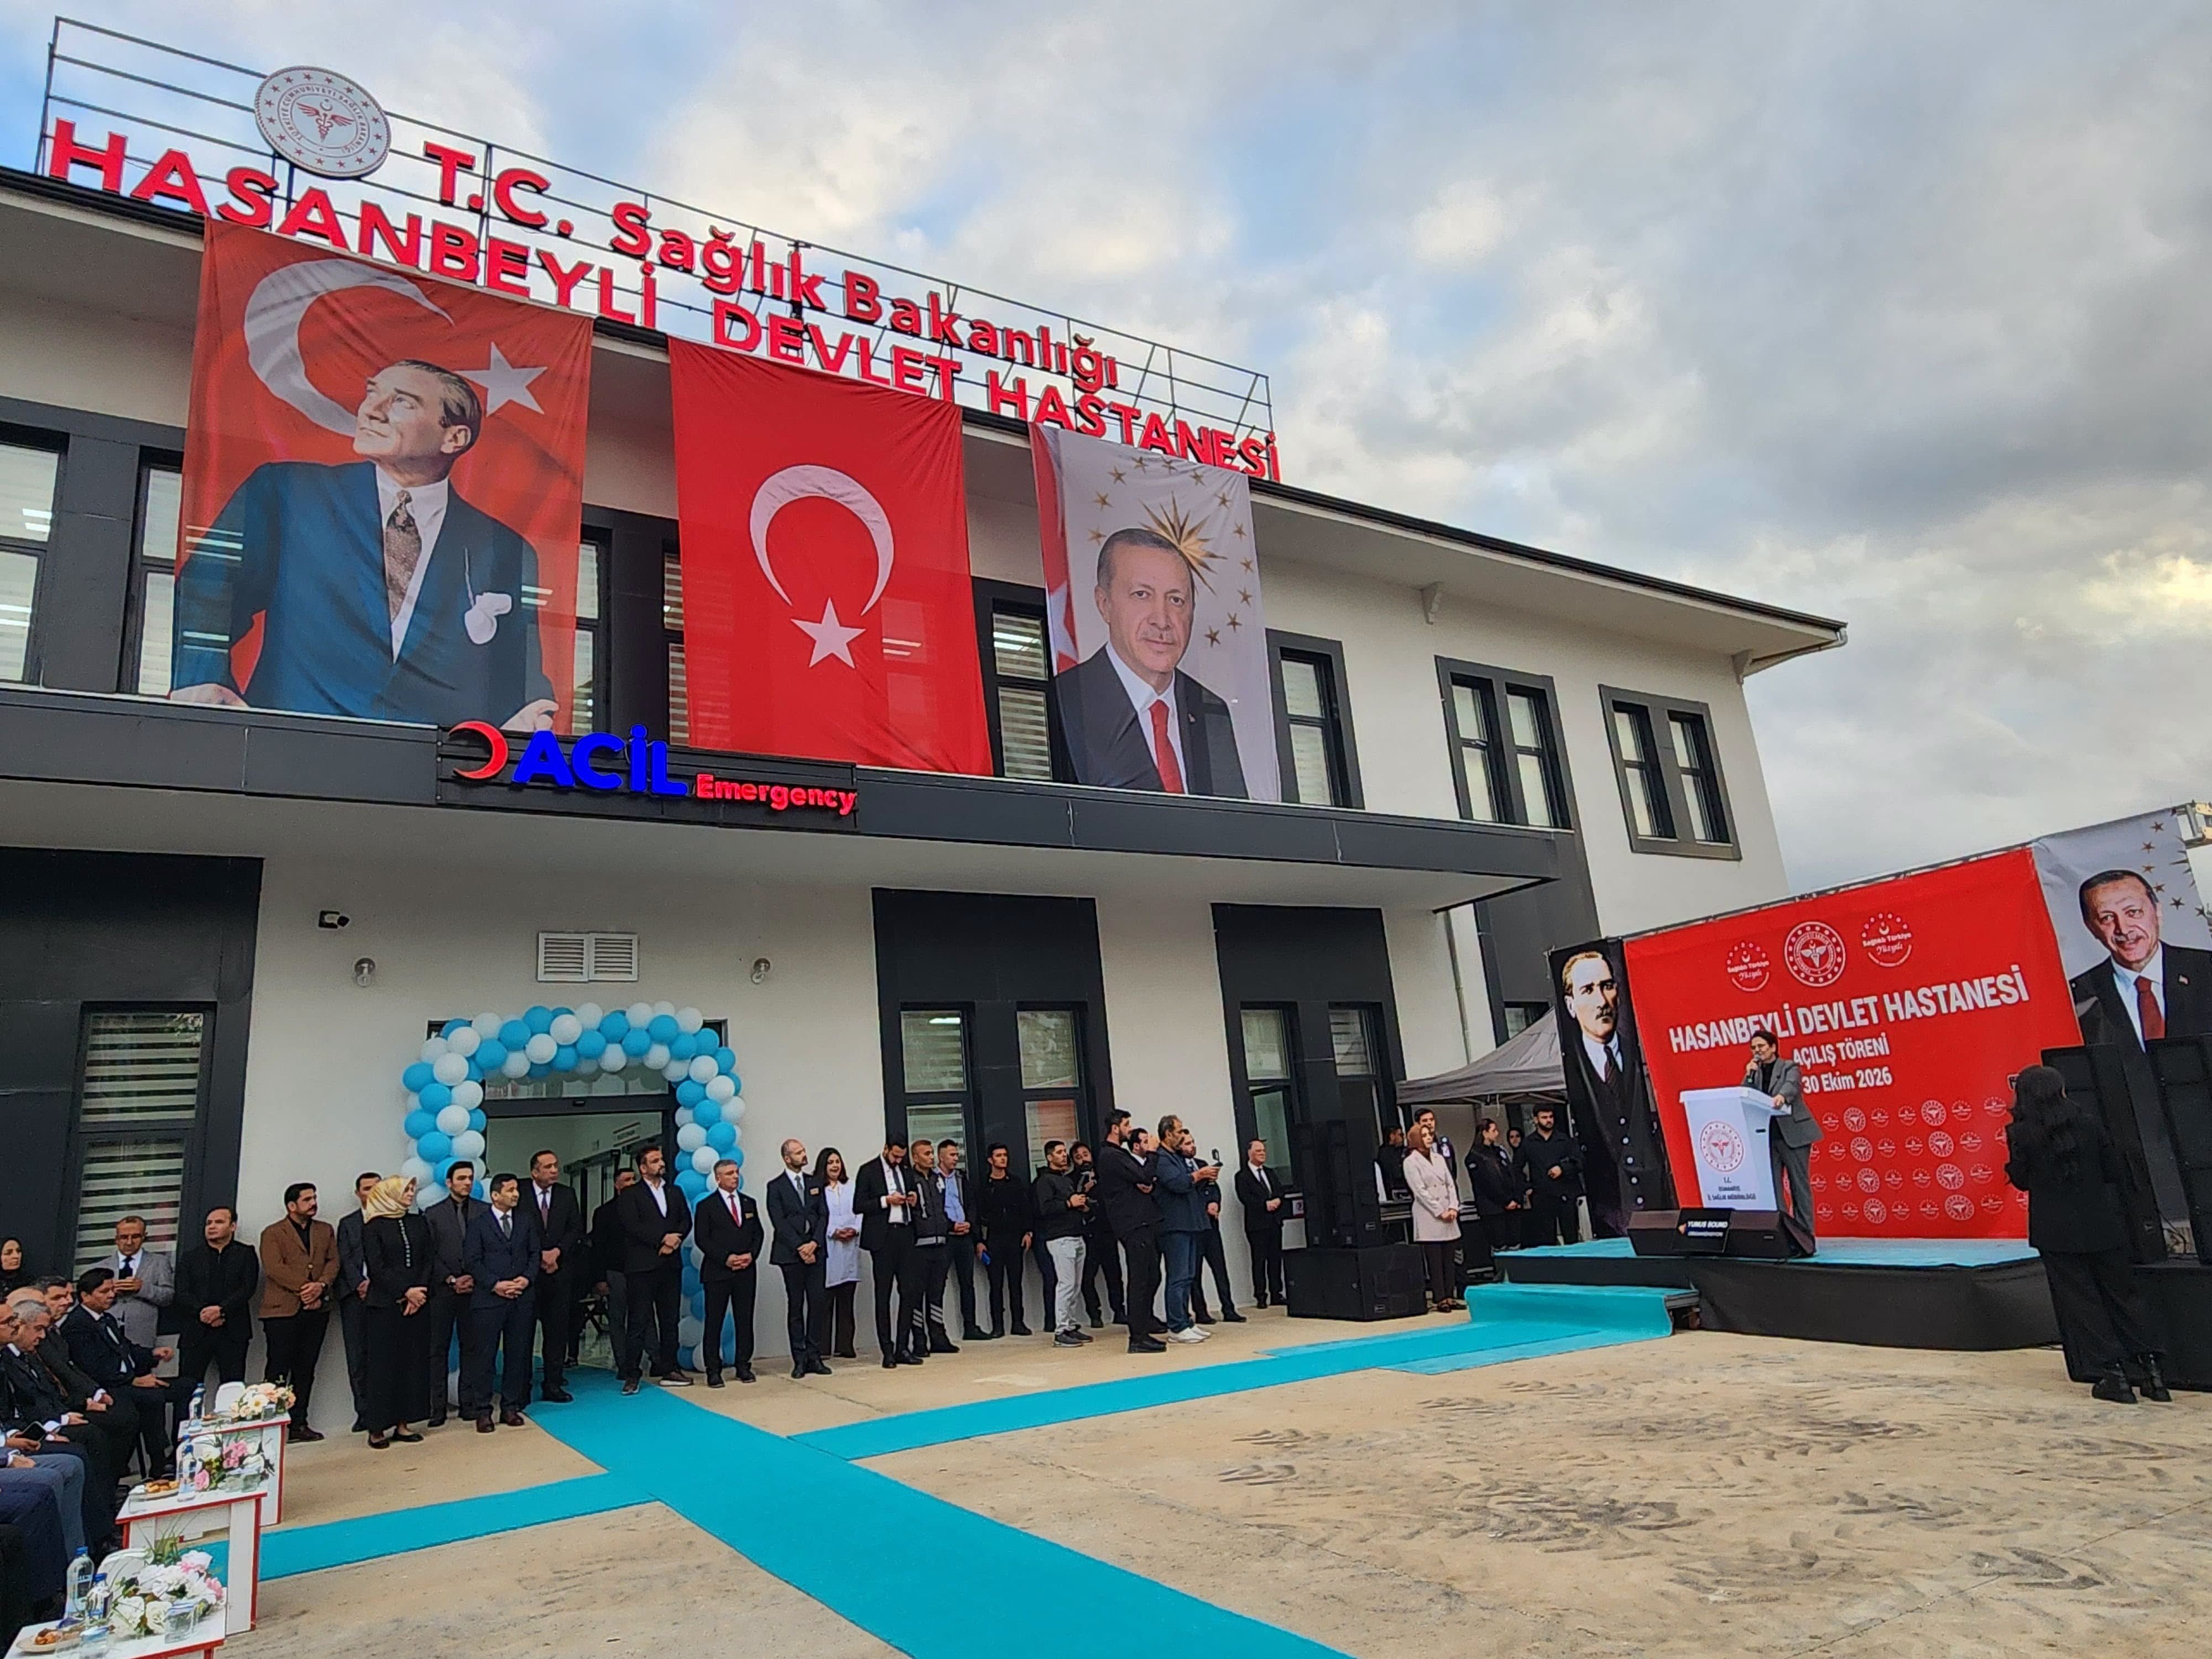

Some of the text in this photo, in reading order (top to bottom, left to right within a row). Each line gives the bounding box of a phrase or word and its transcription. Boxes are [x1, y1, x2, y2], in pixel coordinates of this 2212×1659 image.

[49, 117, 1281, 484] HASANBEYLİ DEVLET HASTANESİ
[425, 140, 1117, 393] T.C. Sağlık Bakanlığı
[511, 723, 857, 816] ACİL Emergency
[1668, 964, 2030, 1053] HASANBEYLİ DEVLET HASTANESİ
[1793, 1031, 1890, 1070] AÇILIŞ TÖRENİ
[1801, 1066, 1893, 1094] 30 Ekim 2026
